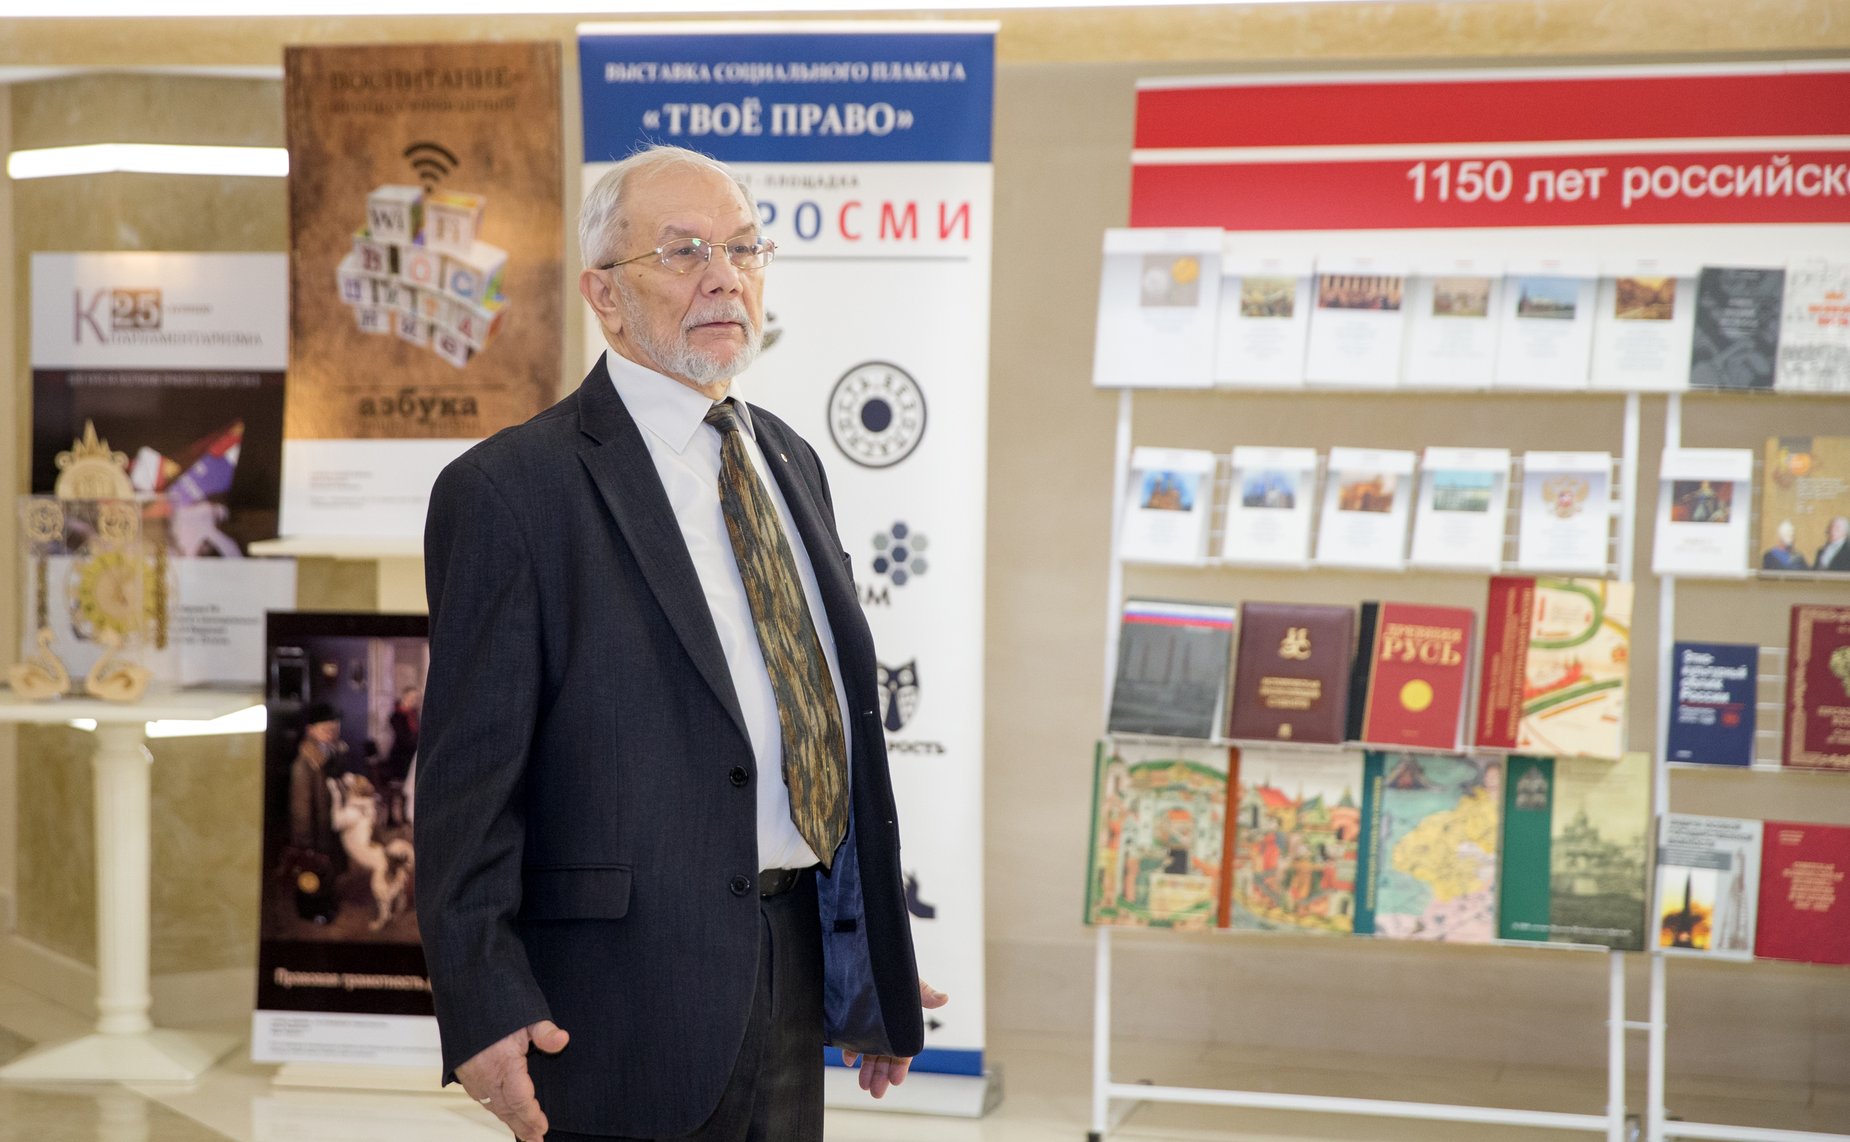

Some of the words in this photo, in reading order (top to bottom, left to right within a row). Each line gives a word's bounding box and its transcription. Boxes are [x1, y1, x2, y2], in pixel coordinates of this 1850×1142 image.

[605, 62, 711, 83] ВЫСТАВКА
[713, 62, 869, 84] СОЦИАЛЬНОГО
[871, 61, 967, 82] ПЛАКАТА
[771, 101, 914, 137] ПРАВО»
[1406, 160, 1514, 203] 1150
[1523, 167, 1609, 202] лет
[358, 387, 478, 424] азбука
[1381, 633, 1462, 666] РУСЬ
